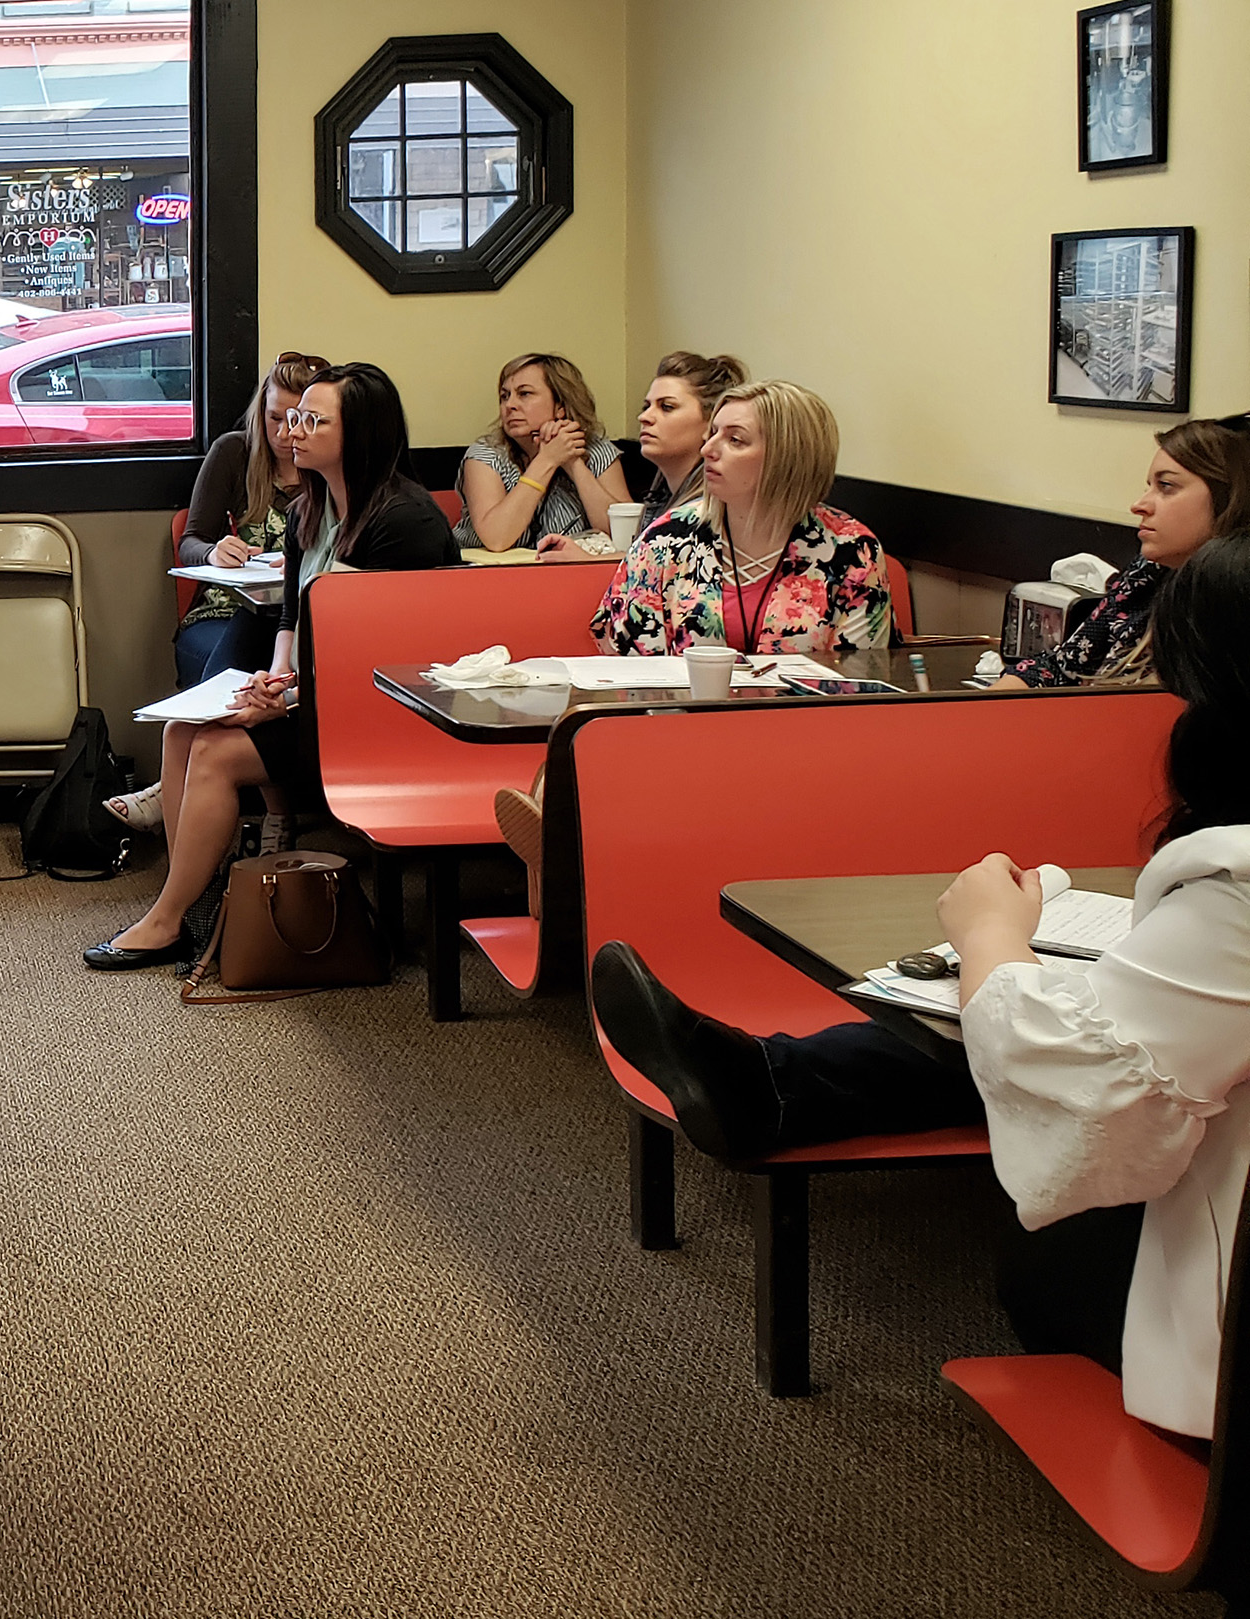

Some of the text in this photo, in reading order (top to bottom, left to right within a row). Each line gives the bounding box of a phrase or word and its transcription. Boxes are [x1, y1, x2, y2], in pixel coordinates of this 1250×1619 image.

[7, 184, 90, 211] Sisters
[141, 199, 190, 220] OPEN
[2, 211, 96, 226] EMPORIUM
[43, 231, 56, 242] H
[7, 251, 96, 263] Gently Used Items
[26, 264, 77, 274] New Items
[30, 276, 73, 287] Antiques
